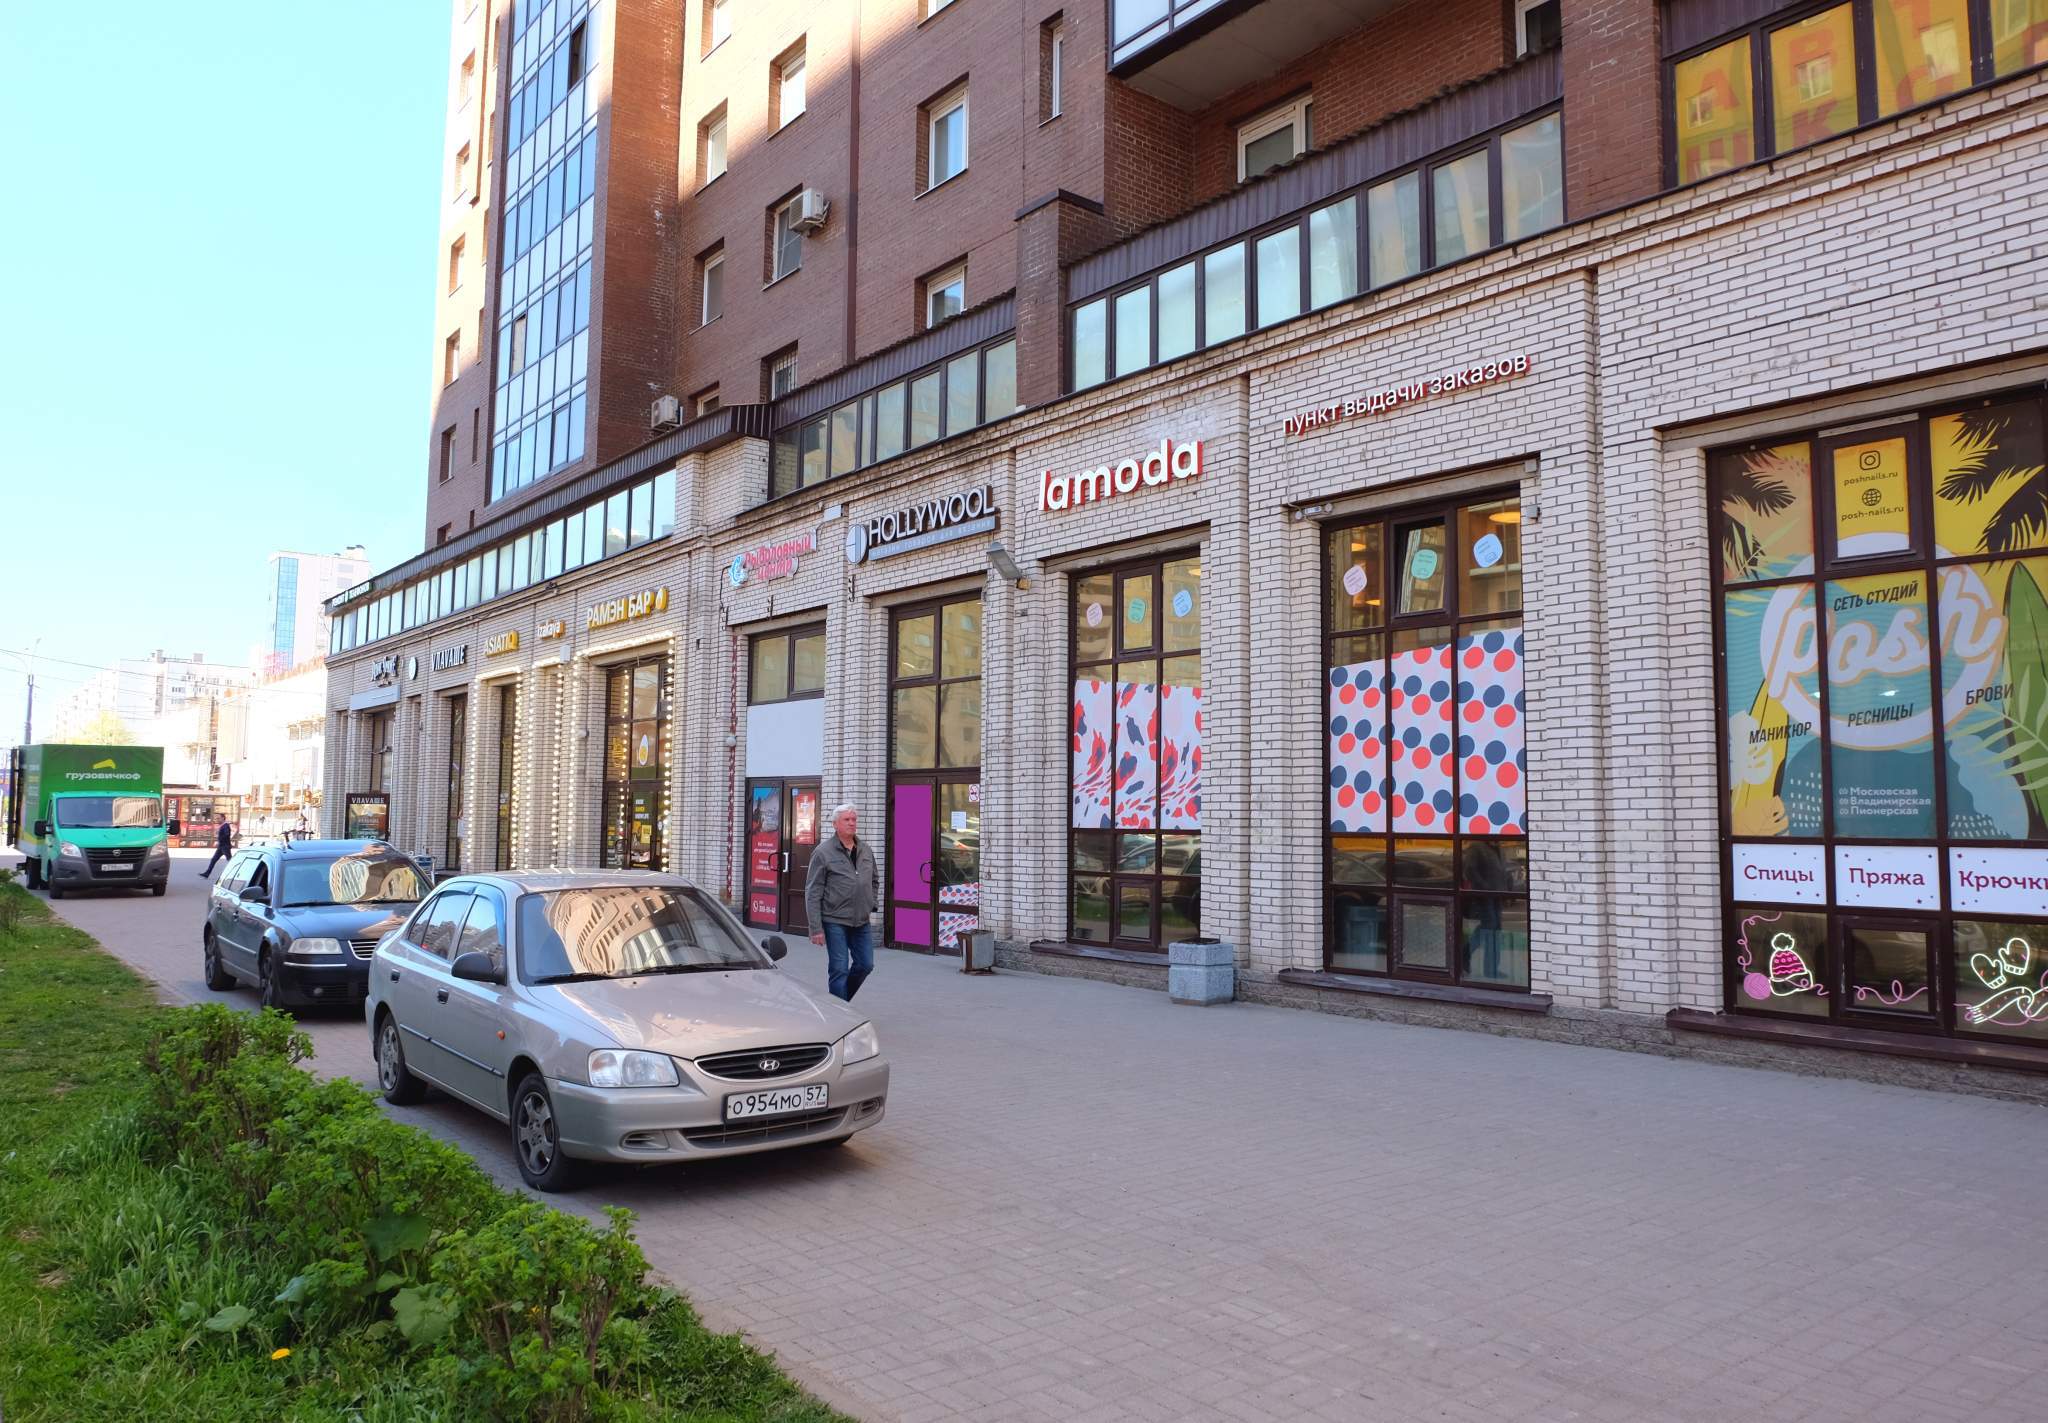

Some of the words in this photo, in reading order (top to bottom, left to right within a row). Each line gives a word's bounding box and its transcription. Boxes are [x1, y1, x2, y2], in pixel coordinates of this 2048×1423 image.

[1282, 404, 1340, 435] пункт
[1344, 384, 1424, 416] выдачи
[1430, 354, 1529, 393] заказов
[1038, 438, 1201, 511] lamoda
[1844, 471, 1898, 486] poshnails.ru
[868, 485, 996, 545] HOLLYWOOL
[1841, 505, 1904, 521] posh-nails.ru
[1833, 594, 1863, 612] СЕТЬ
[1866, 580, 1918, 605] СТУДИЙ
[587, 597, 626, 629] РАМЭН
[628, 590, 653, 618] БАР
[1965, 683, 2014, 705] БРОВИ
[1847, 703, 1914, 727] РЕСНИЦЫ
[1749, 721, 1812, 744] МАНИКЮР
[65, 772, 141, 781] грузовичкоф
[1850, 787, 1918, 796] Московская
[1850, 796, 1931, 807] Владимирская
[1850, 806, 1919, 816] Пионерская
[1744, 864, 1814, 883] Спицы
[1849, 867, 1926, 888] Пряжа
